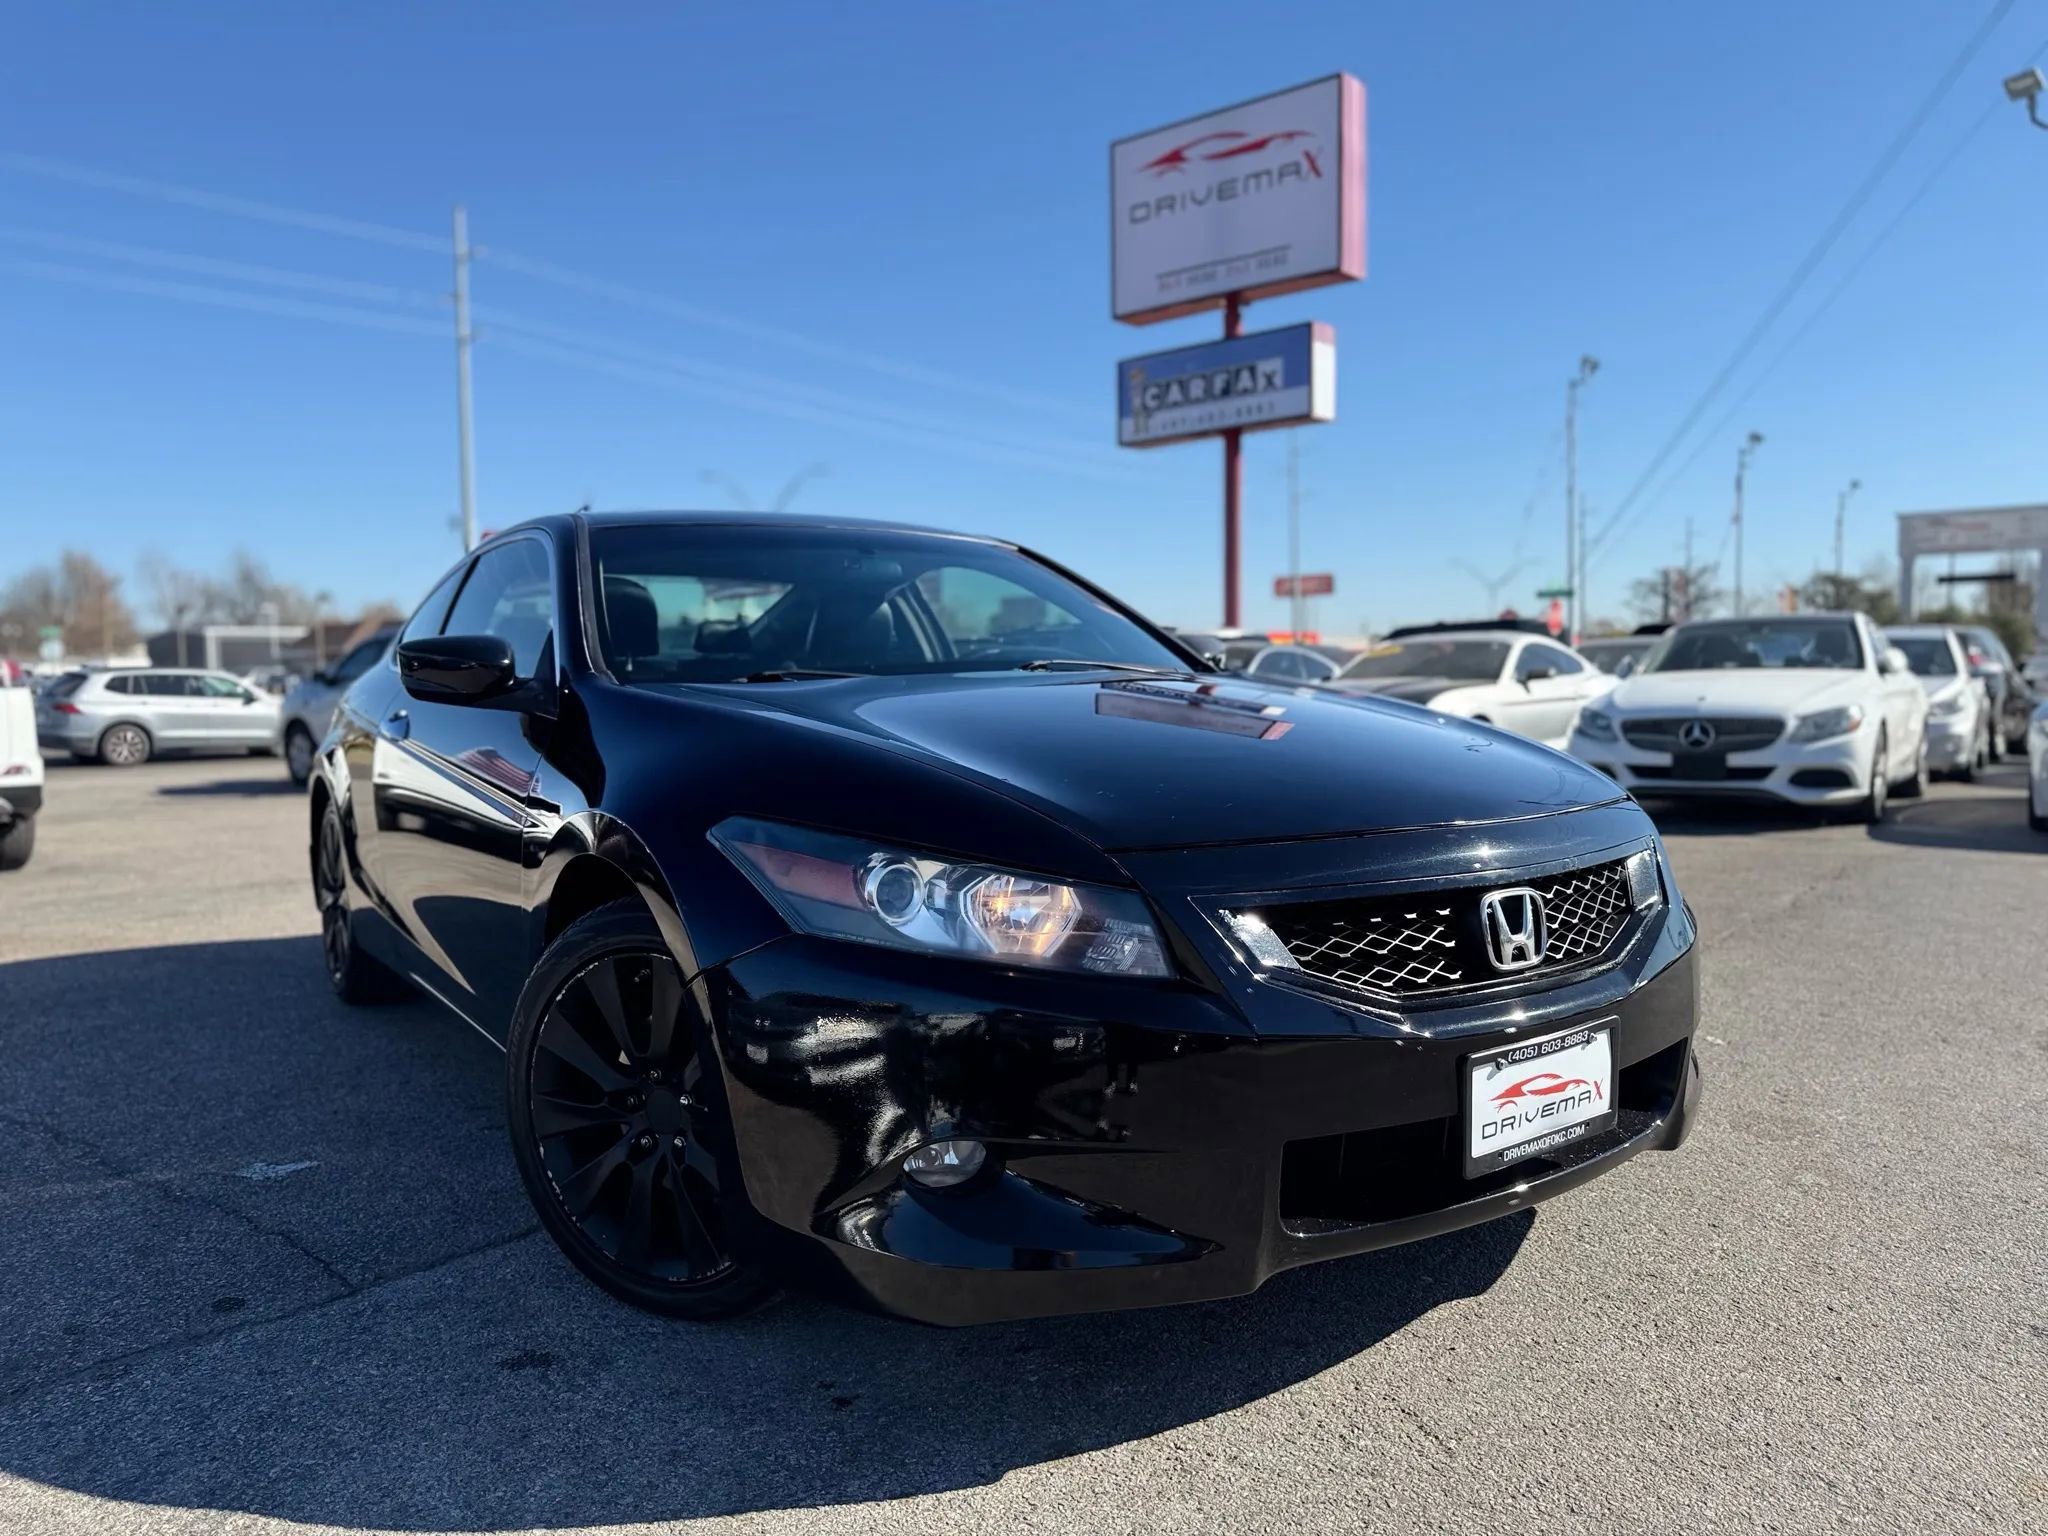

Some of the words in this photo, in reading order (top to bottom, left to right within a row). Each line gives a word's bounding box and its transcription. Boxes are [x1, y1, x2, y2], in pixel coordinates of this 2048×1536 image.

[1129, 146, 1323, 224] DRIVEMAX
[1143, 367, 1278, 409] CARFAX
[1508, 1046, 1538, 1063] (405)
[1541, 1030, 1589, 1054] 603-8883
[1482, 1078, 1604, 1140] DRIVEMAX
[1503, 1124, 1585, 1162] DRIVEMAXOFOKC.COM
